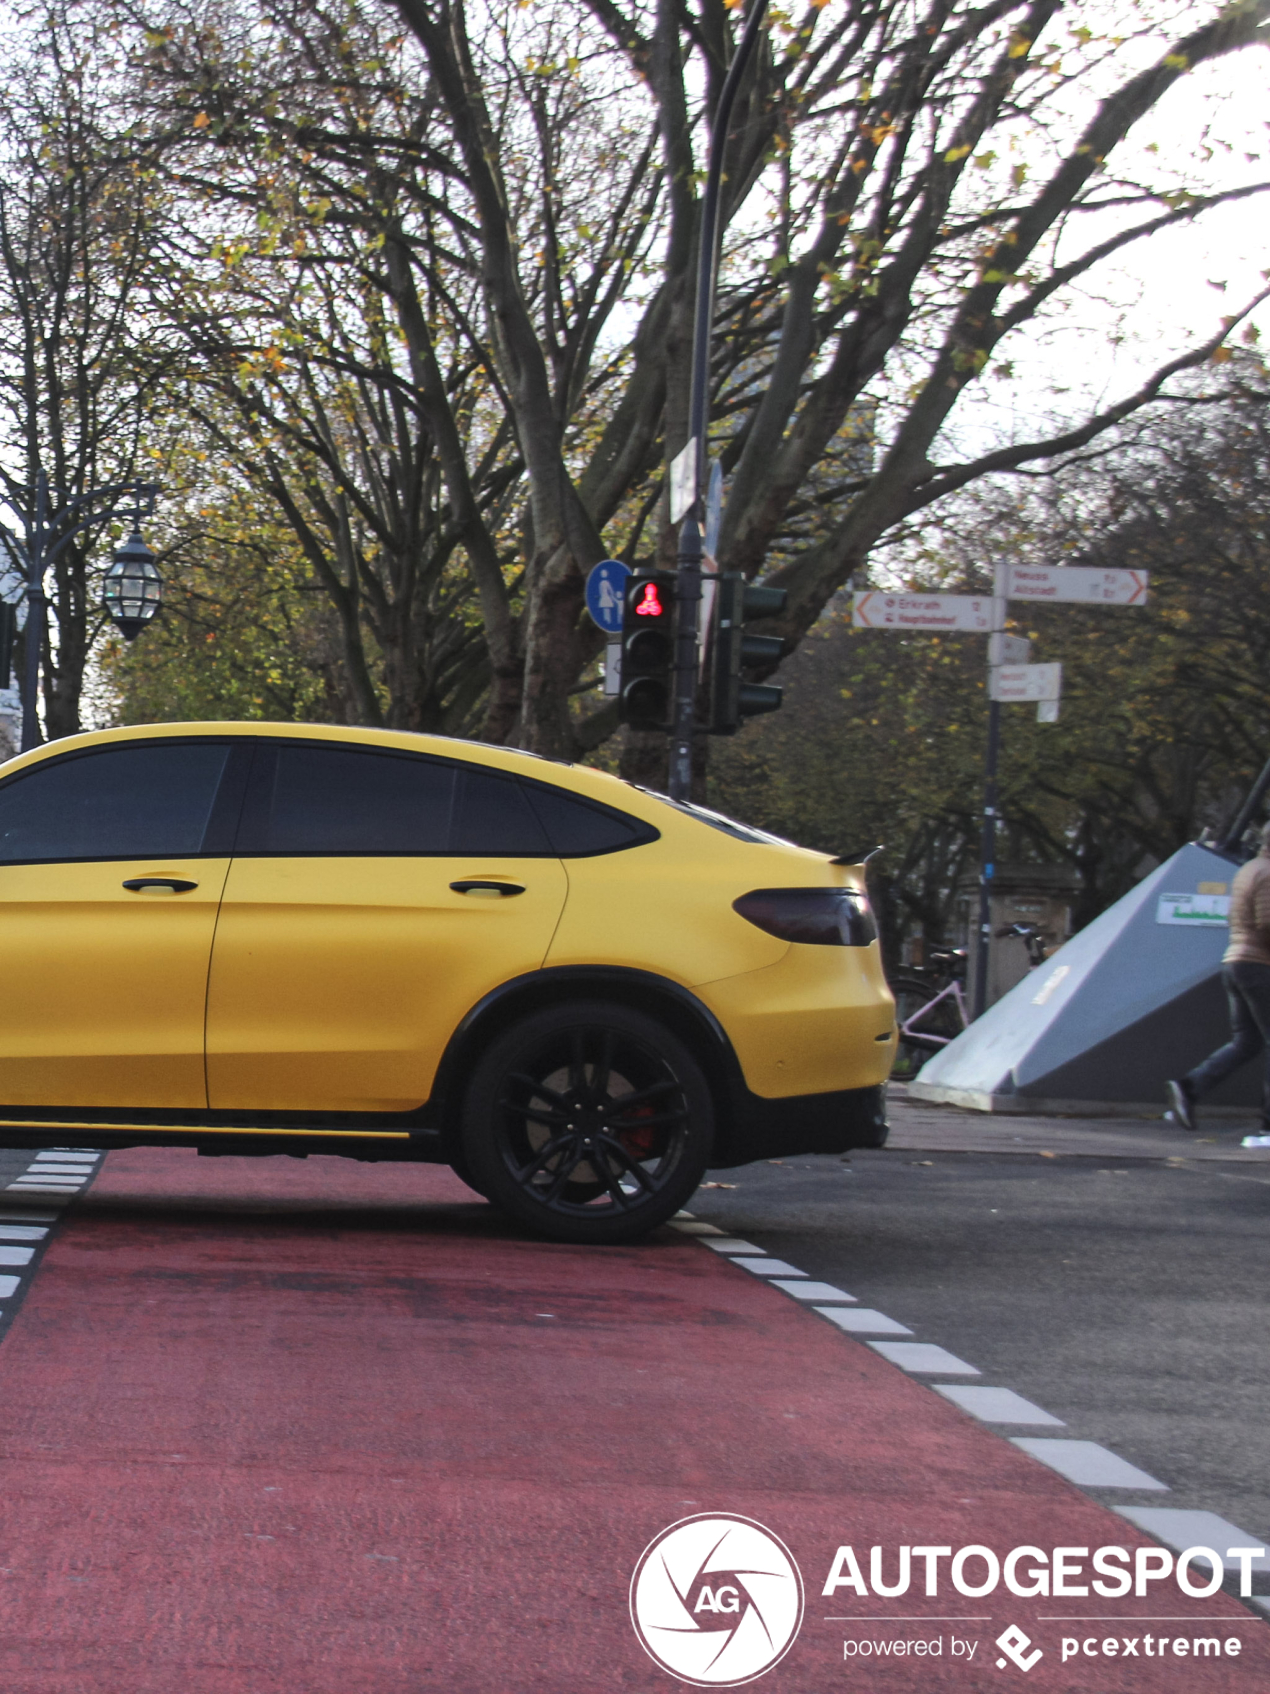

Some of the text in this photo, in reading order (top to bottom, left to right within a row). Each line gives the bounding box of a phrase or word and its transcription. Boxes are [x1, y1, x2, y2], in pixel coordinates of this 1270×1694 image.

[1014, 570, 1049, 581] Neuss
[1014, 584, 1057, 596] Altstadt
[898, 599, 941, 610] Erkrath
[898, 613, 956, 625] Hauptbahnhof
